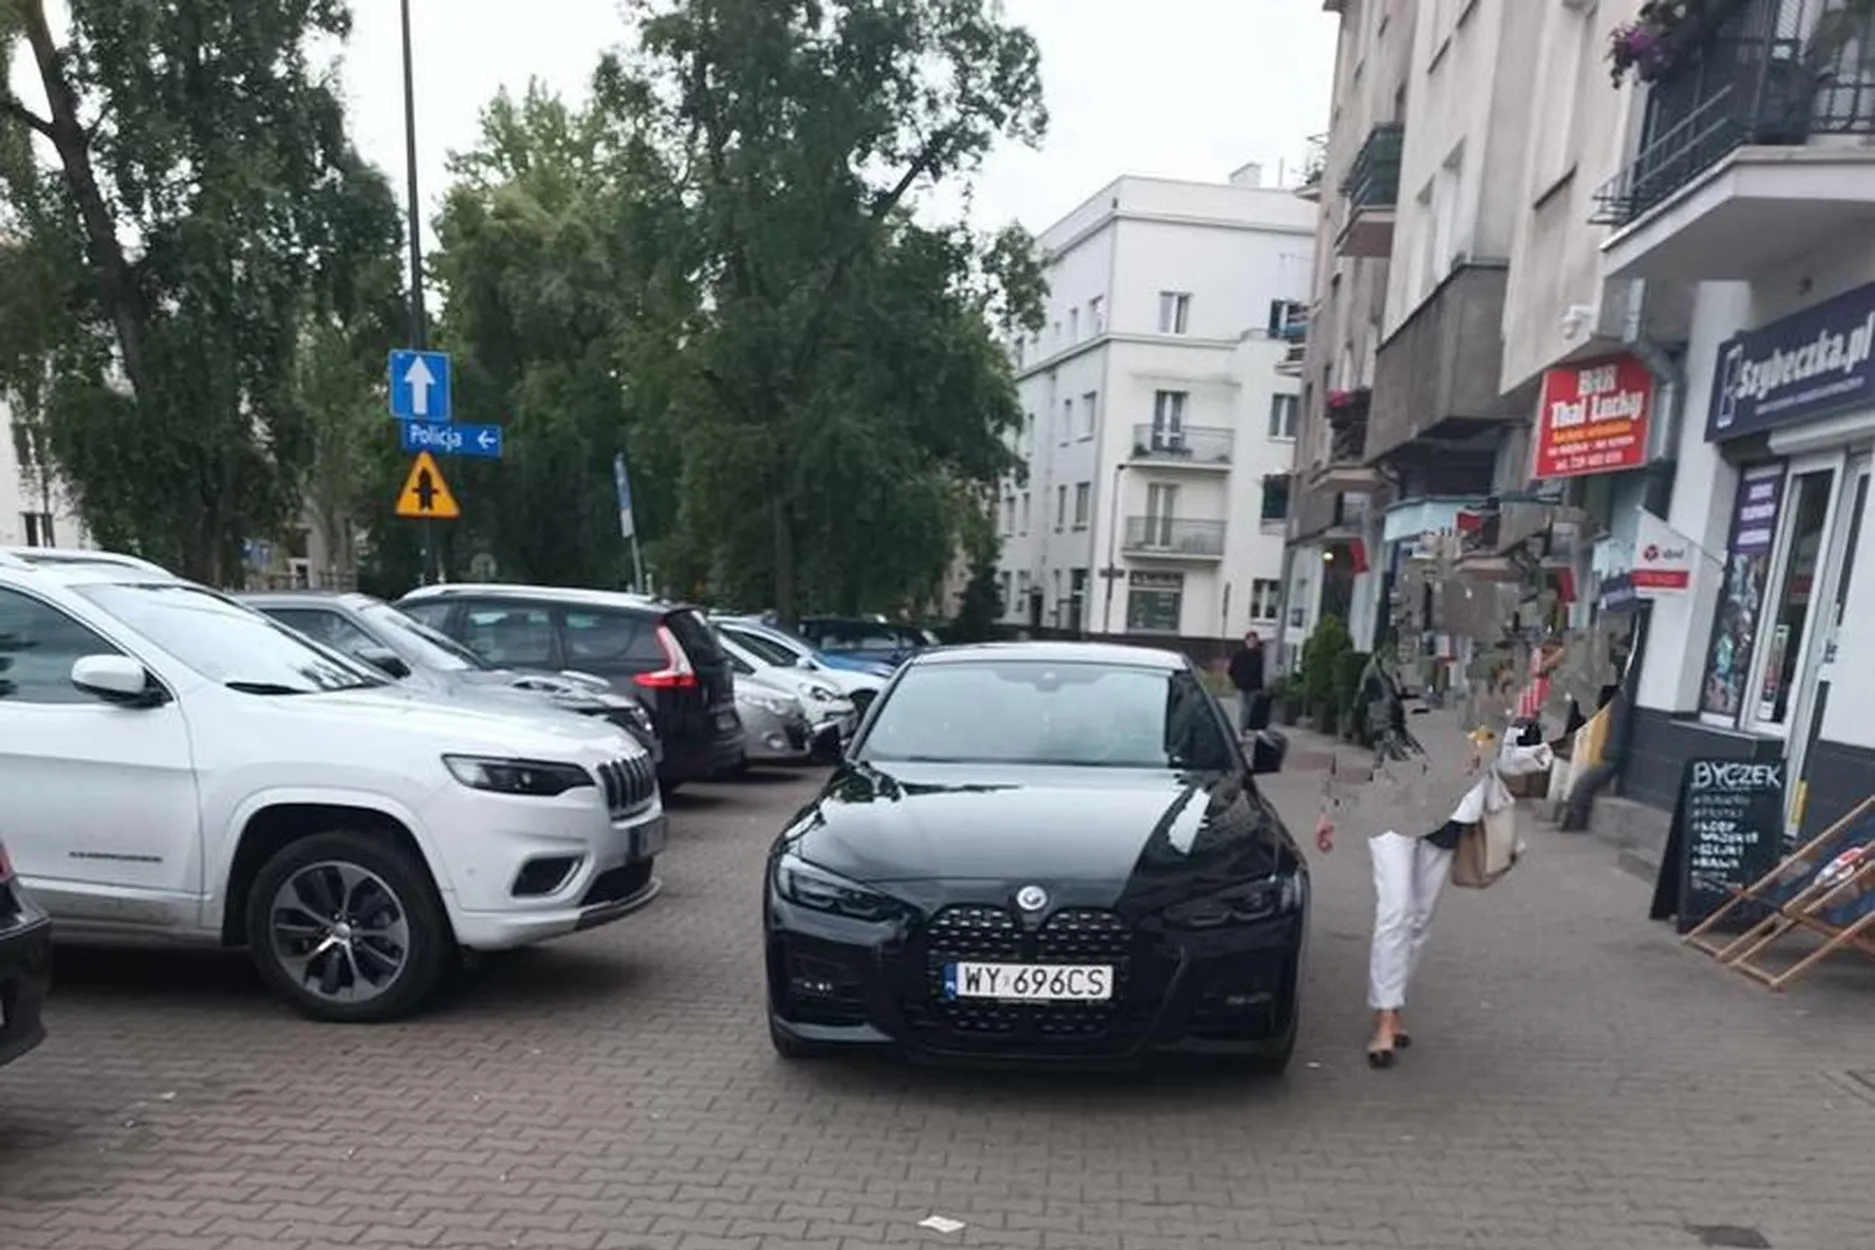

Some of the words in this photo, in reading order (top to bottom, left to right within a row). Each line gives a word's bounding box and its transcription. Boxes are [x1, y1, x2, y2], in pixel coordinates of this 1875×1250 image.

[1736, 311, 1875, 400] Szybeczka.pl
[409, 423, 463, 451] Policja
[1691, 760, 1782, 788] BYCZEK
[964, 966, 1001, 994] WY
[1013, 968, 1104, 996] 696CS
